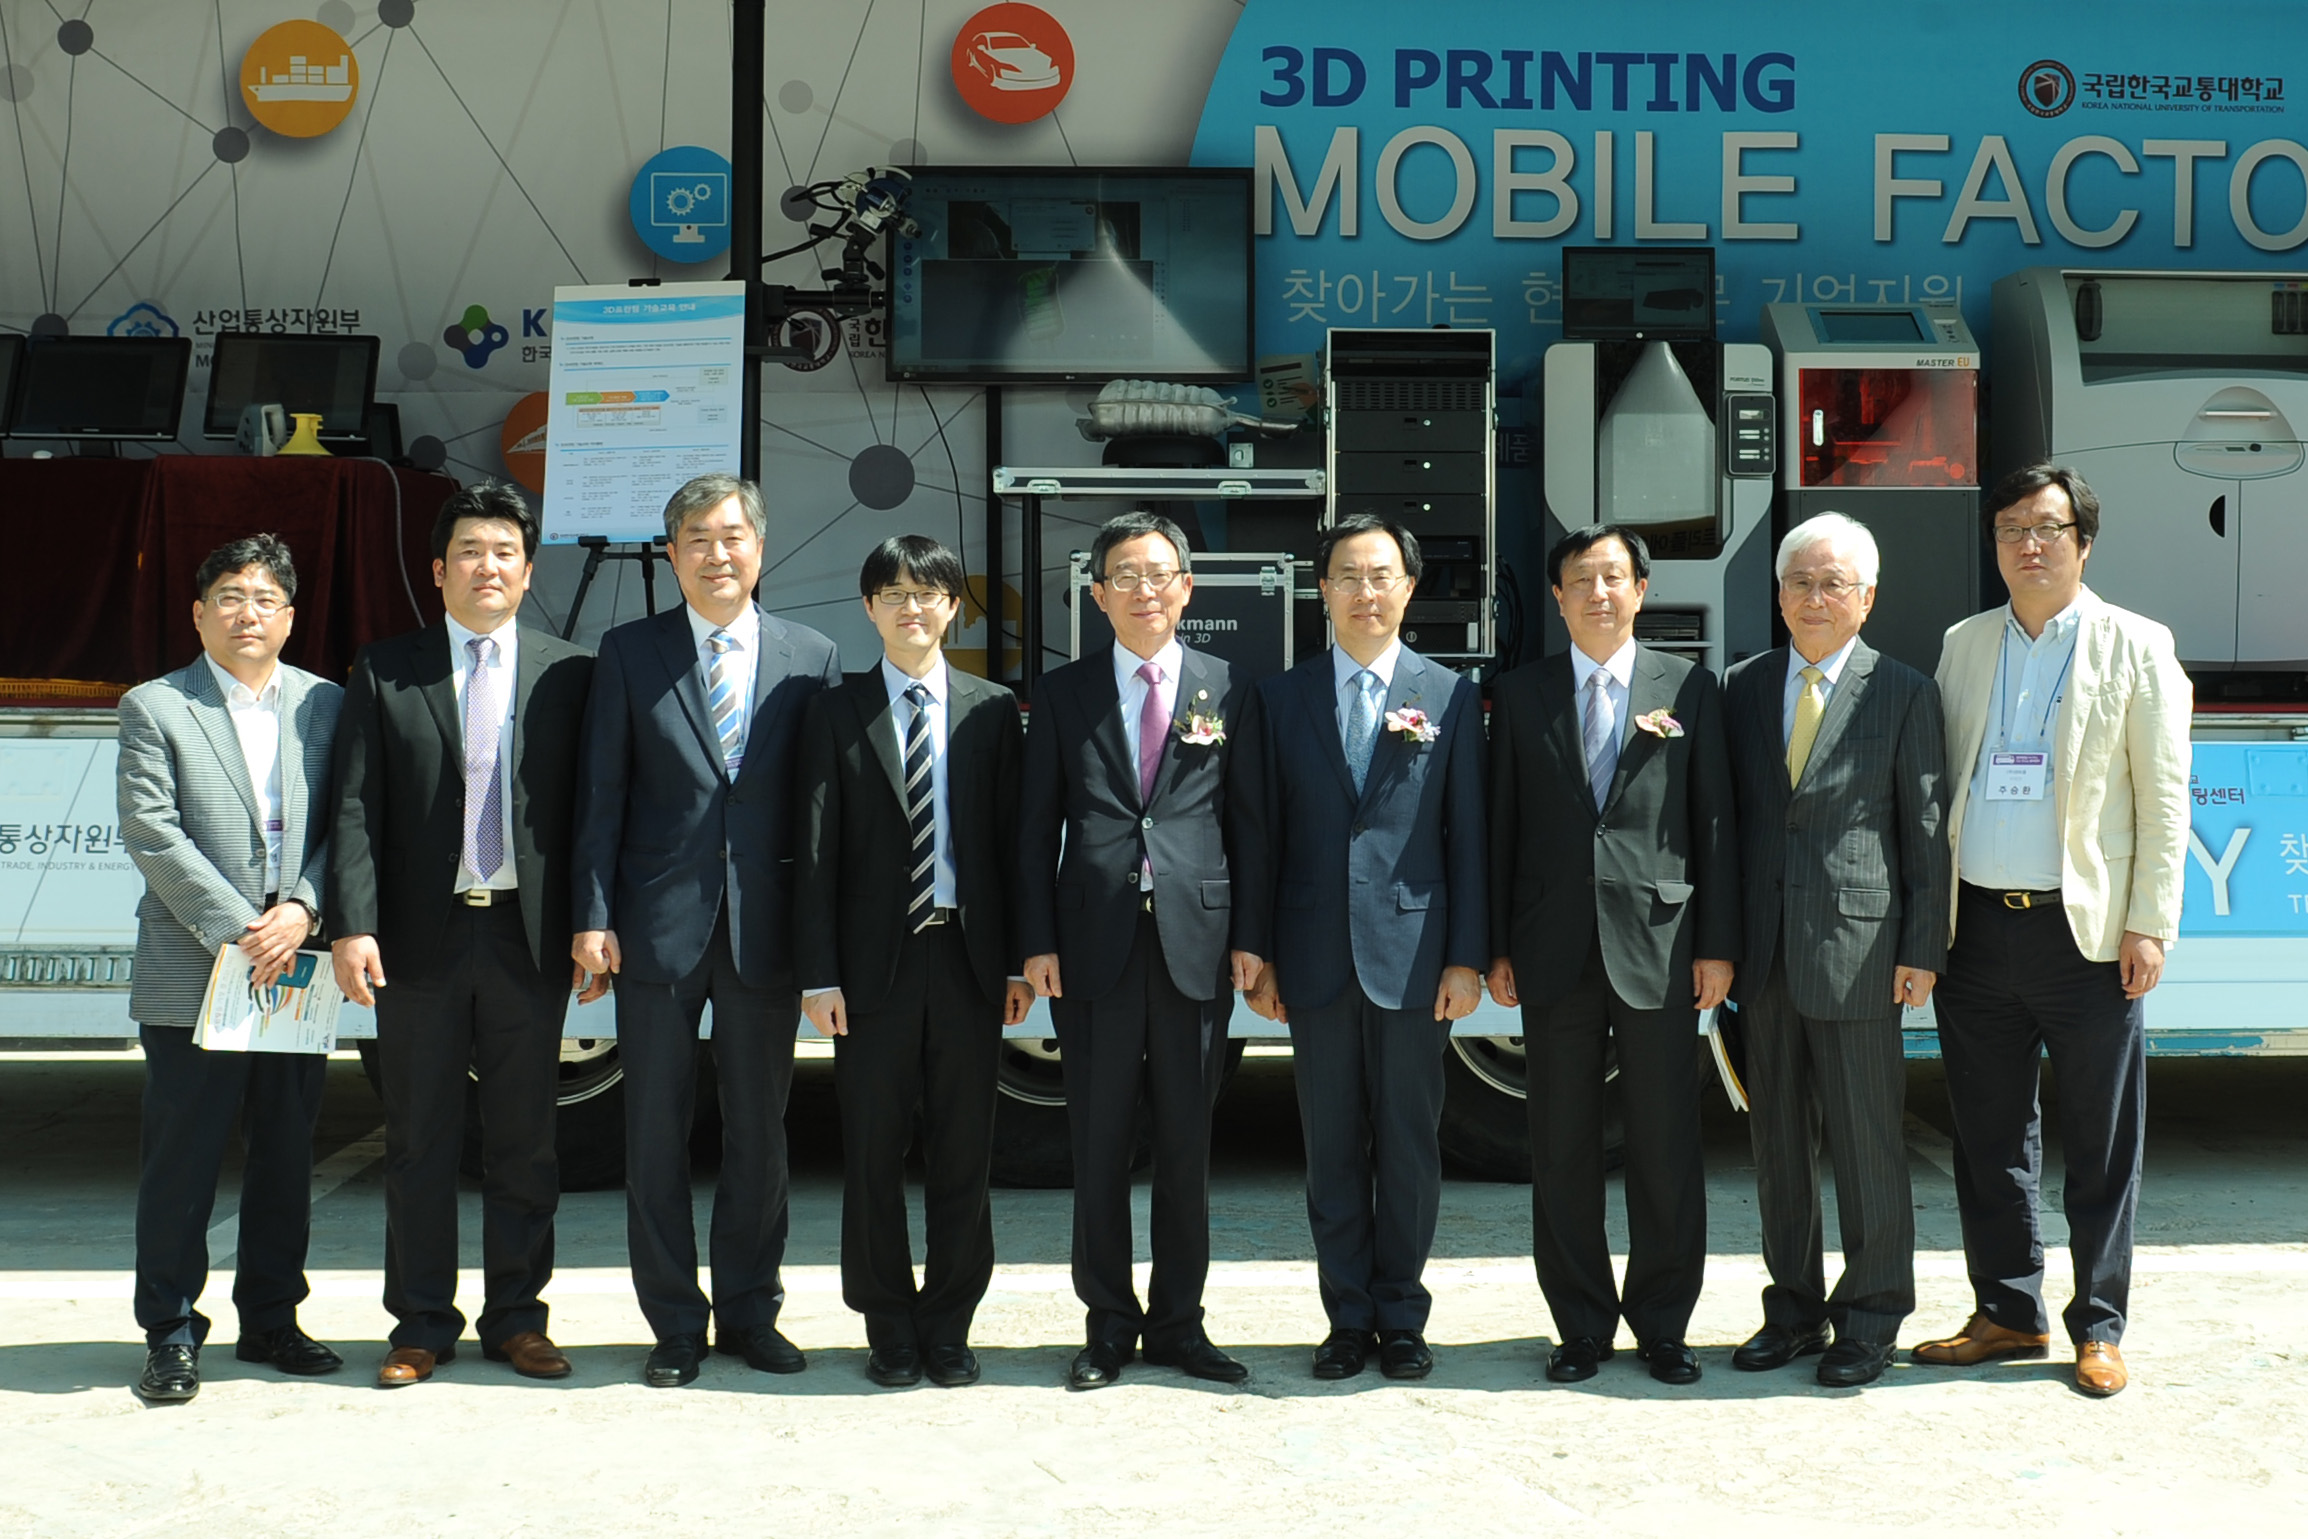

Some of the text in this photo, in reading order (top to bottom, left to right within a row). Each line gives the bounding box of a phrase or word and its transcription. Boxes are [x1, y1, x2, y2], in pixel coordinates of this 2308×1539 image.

[1260, 45, 1796, 114] 3D PRINTING
[2082, 73, 2285, 102] 국립한국교통대학교
[2082, 101, 2285, 114] KOREA NATIONAL UNIVERSITY OF TRANSPORTATION
[1254, 125, 2308, 252] MOBILE FACTO
[1282, 269, 1493, 324] 찾아가는
[193, 308, 361, 336] 산업통상자원부
[1916, 357, 1970, 367] MASTER EU
[1194, 633, 1211, 643] 3D
[37, 861, 85, 869] INDUSTRY
[88, 862, 95, 870] &
